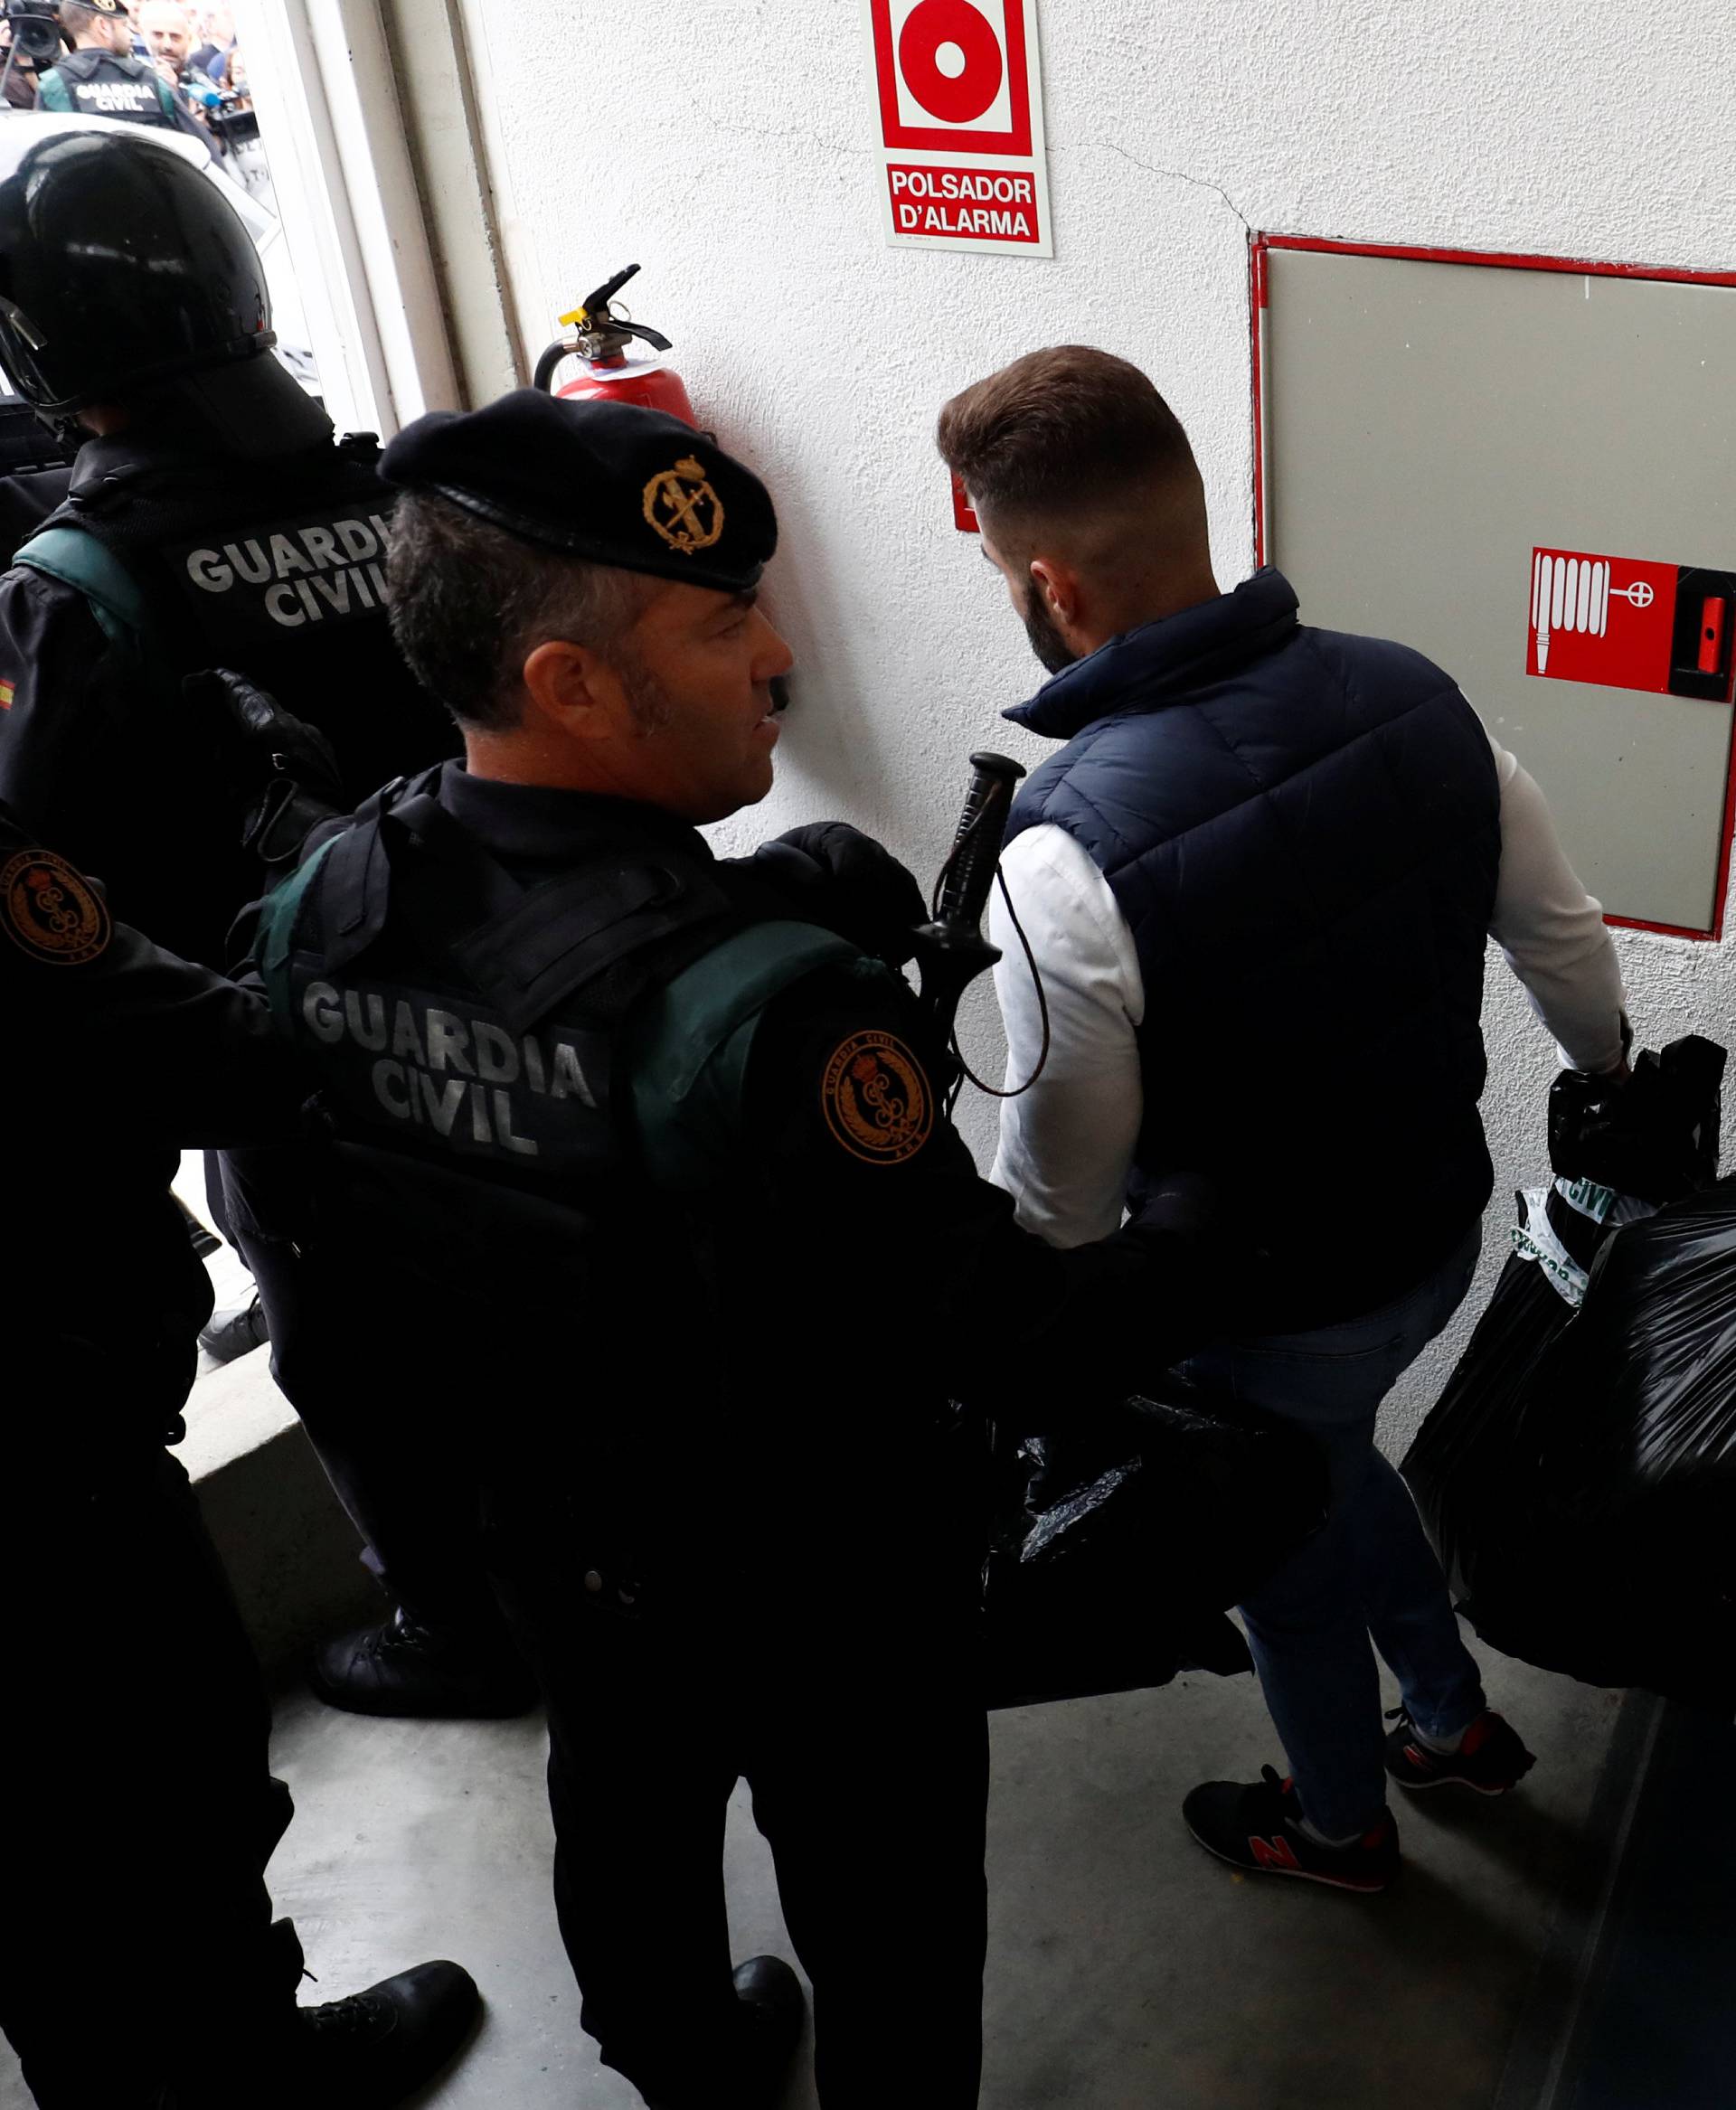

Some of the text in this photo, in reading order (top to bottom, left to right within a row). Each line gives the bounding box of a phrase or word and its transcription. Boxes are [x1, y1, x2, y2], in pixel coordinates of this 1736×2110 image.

[76, 83, 155, 99] GUARDIA
[97, 98, 144, 110] CIVIL
[891, 170, 1032, 203] POLSADOR
[900, 204, 1031, 236] D'ALARMA
[186, 514, 392, 593] GUARDI
[303, 981, 598, 1108] GUARDIA
[372, 1058, 539, 1155] CIVIL
[1248, 1835, 1300, 1868] N
